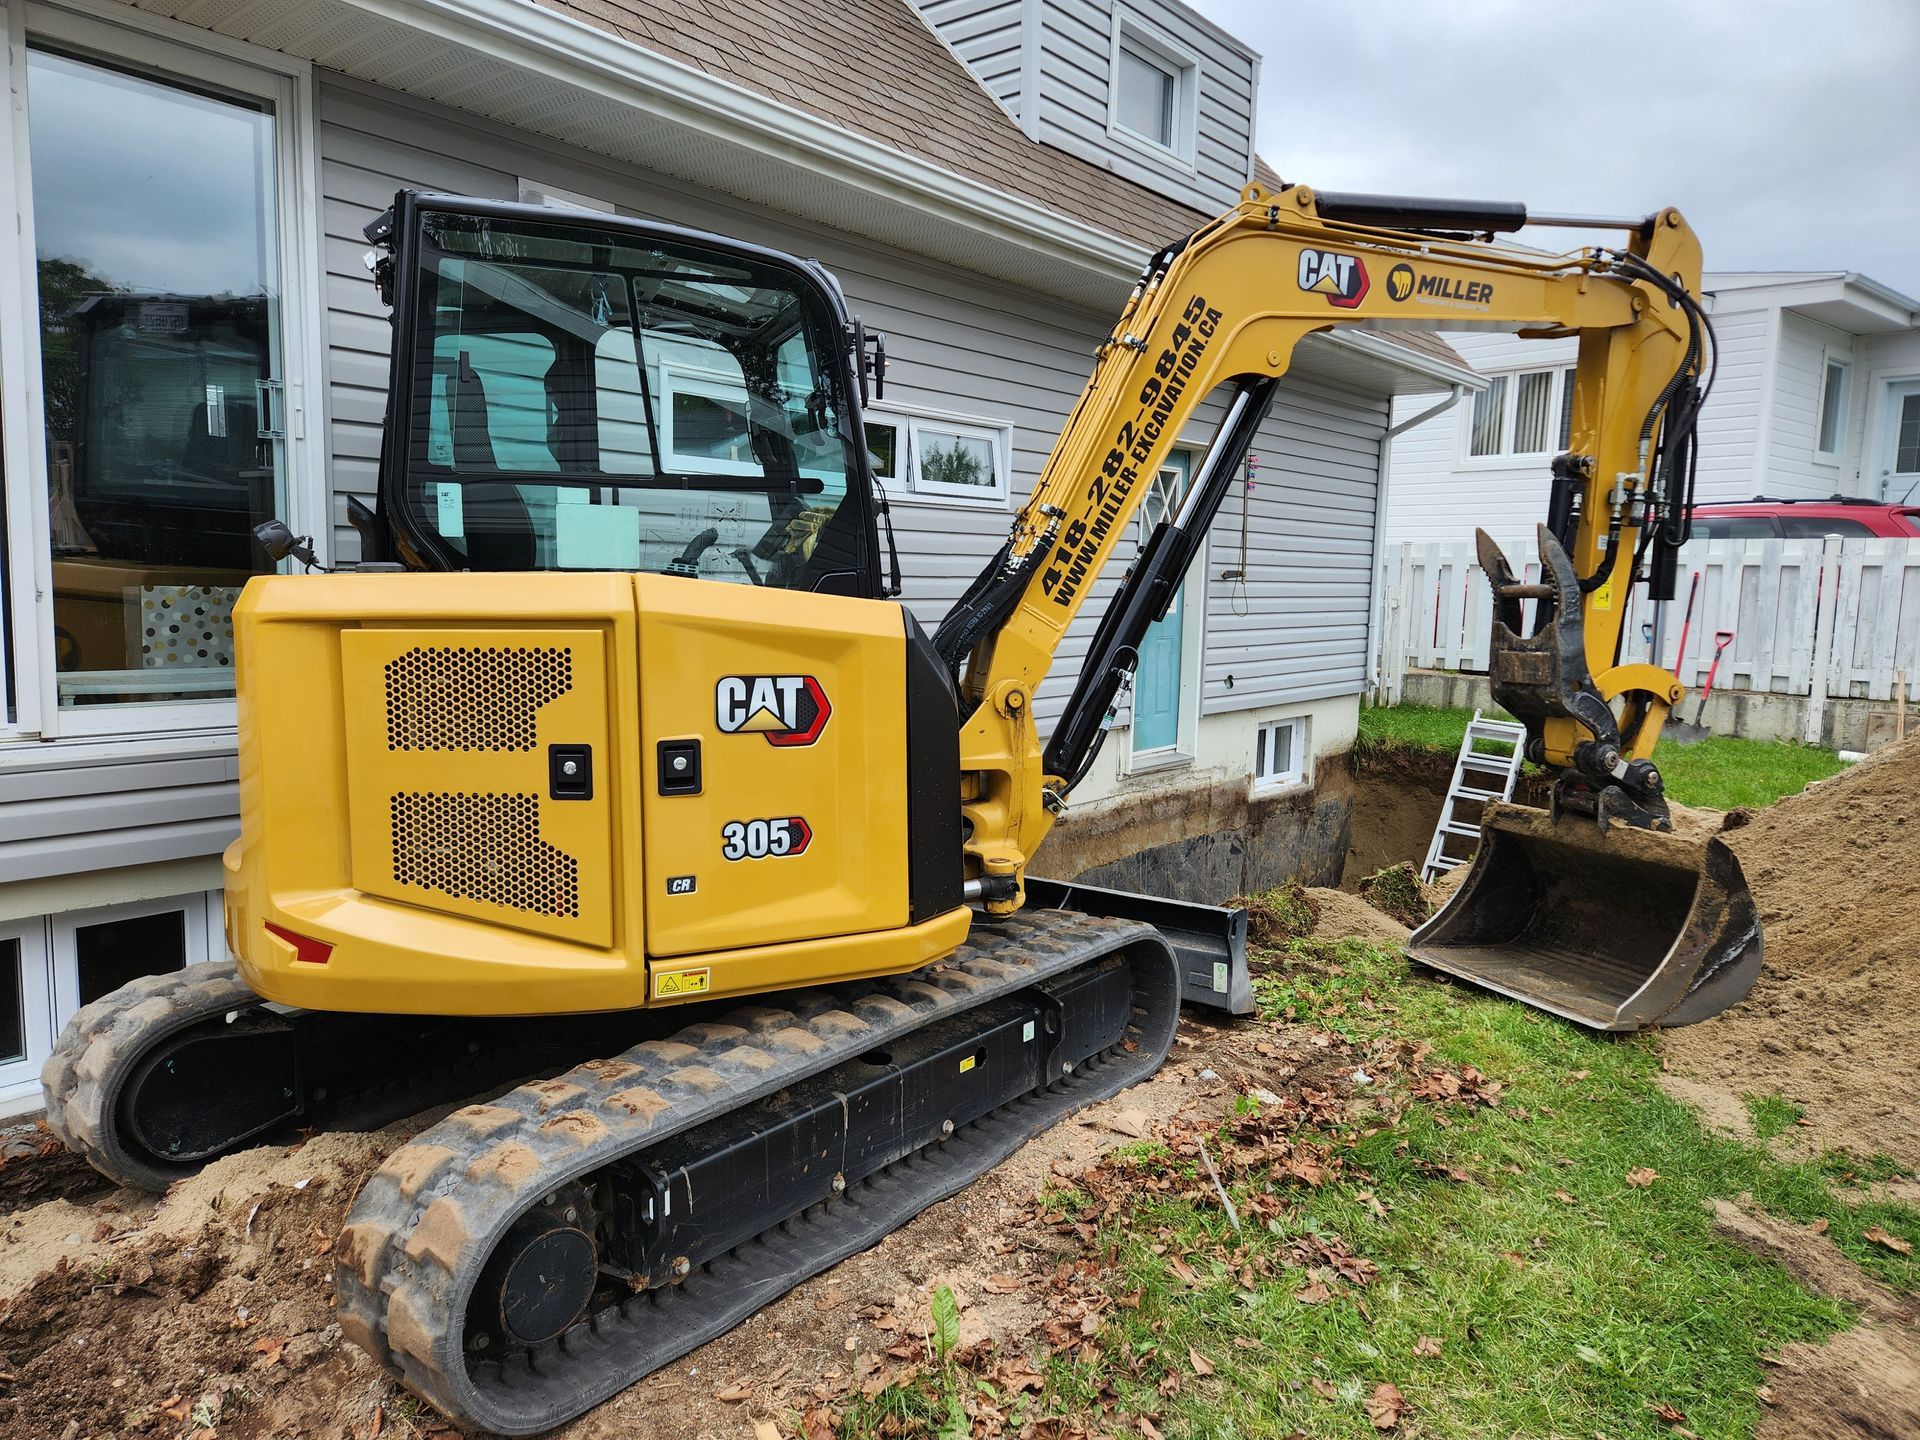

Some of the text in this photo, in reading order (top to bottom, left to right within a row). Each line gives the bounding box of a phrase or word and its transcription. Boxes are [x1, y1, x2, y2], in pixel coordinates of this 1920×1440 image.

[1298, 248, 1355, 296] CAT
[1417, 274, 1494, 304] MILLER
[1041, 295, 1205, 597] 418-282-9845
[1053, 307, 1224, 607] WWW.MILLER-EXCAVATION.CA
[717, 676, 804, 732] CAT
[723, 818, 791, 861] 305
[672, 877, 691, 893] CR
